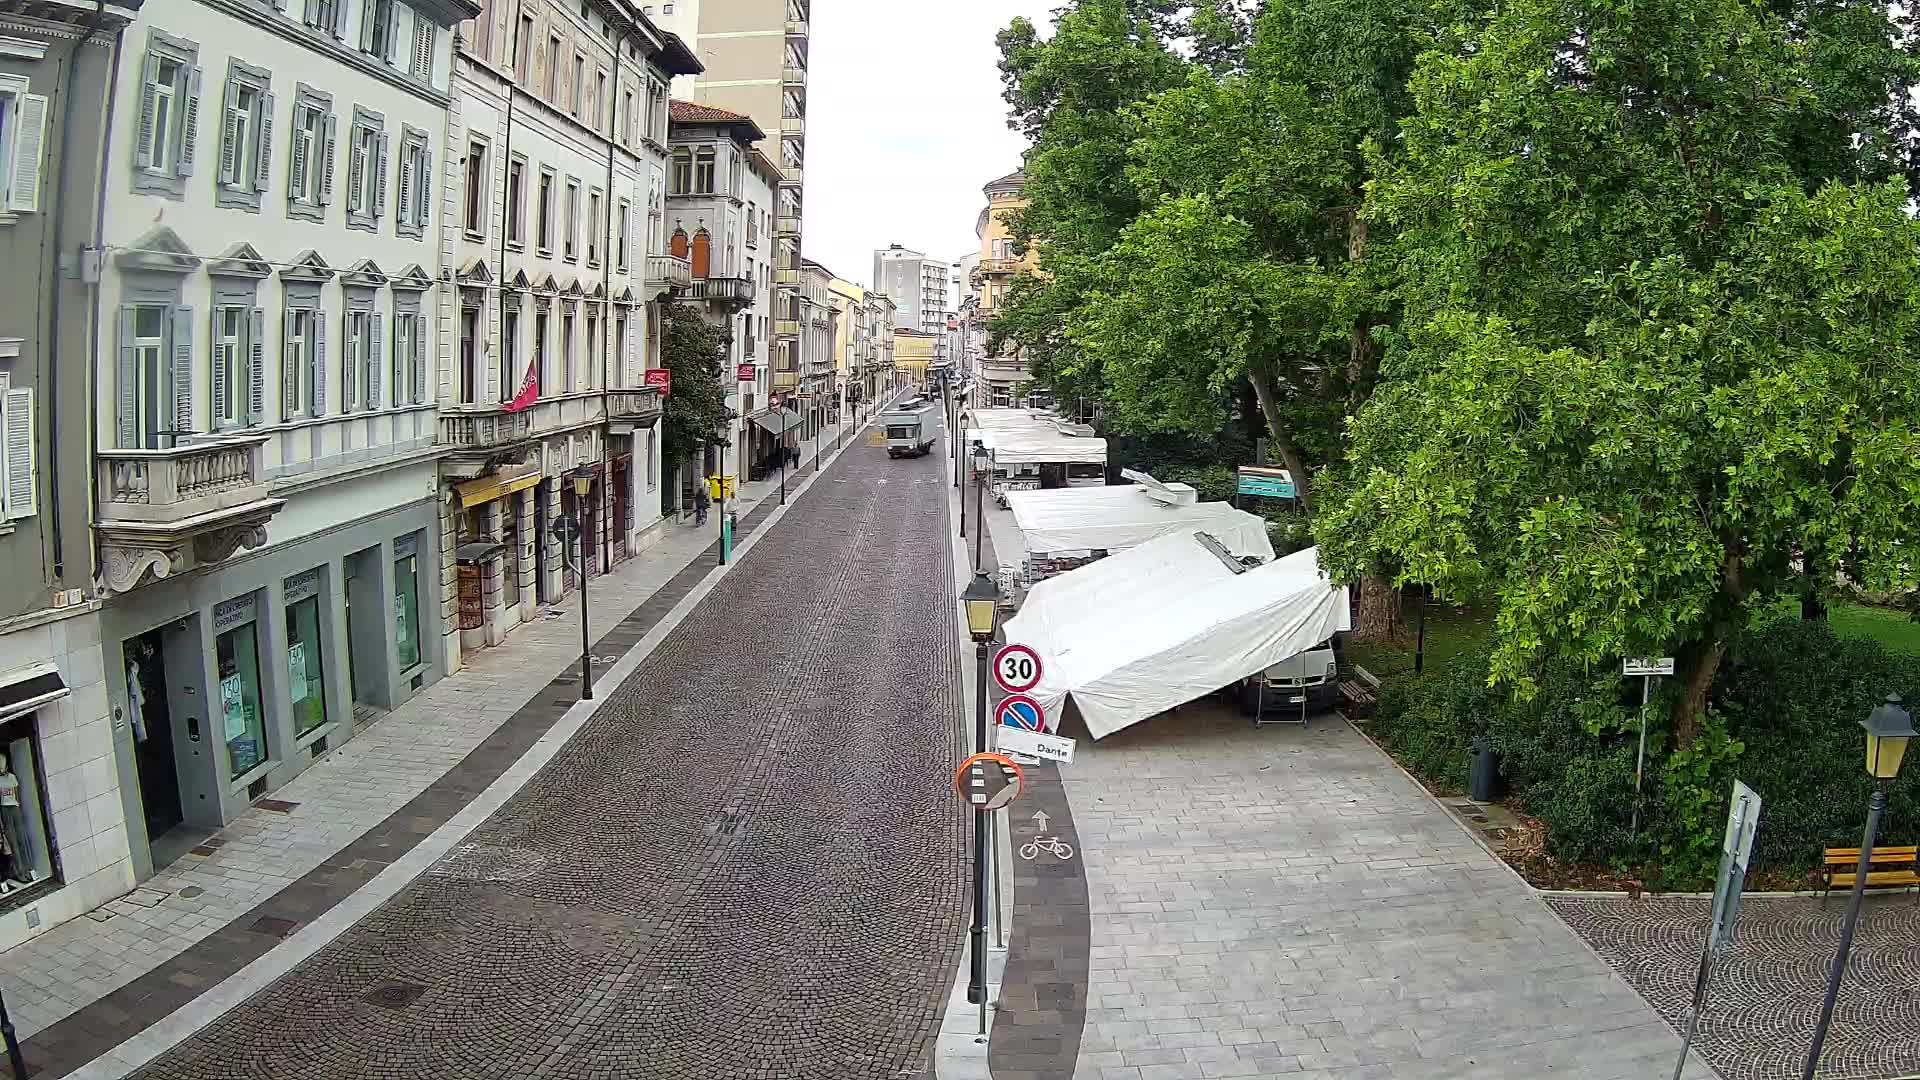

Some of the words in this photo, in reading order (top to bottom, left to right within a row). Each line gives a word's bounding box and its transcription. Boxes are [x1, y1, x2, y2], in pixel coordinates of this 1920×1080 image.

[1005, 657, 1032, 680] 30
[222, 677, 240, 698] 130
[1037, 743, 1067, 757] Dante
